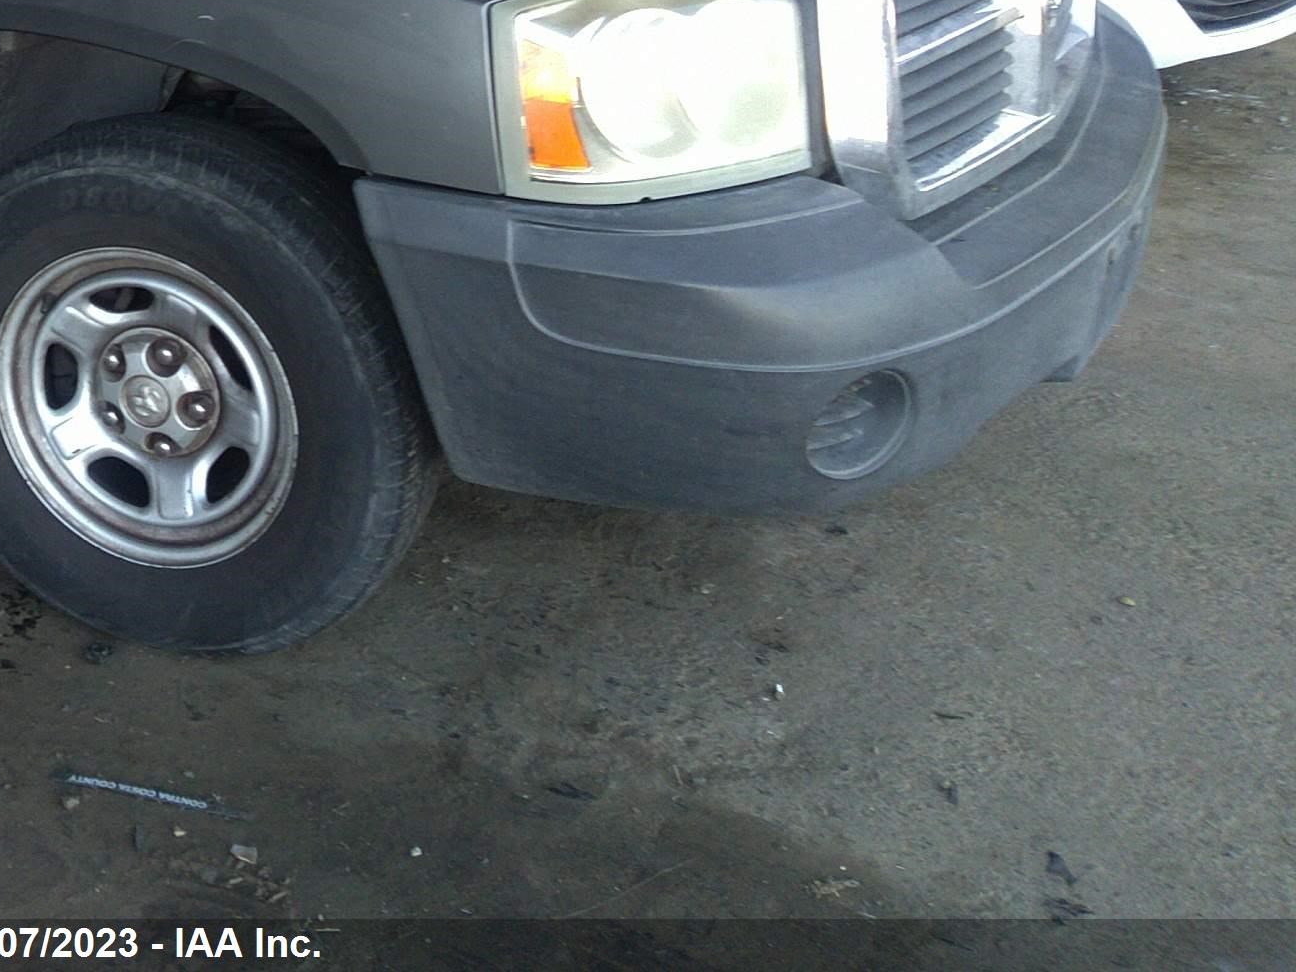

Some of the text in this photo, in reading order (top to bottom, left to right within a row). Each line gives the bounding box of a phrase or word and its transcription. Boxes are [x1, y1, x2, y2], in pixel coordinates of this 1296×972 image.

[66, 775, 208, 808] CONTRA COSTA COUNTY
